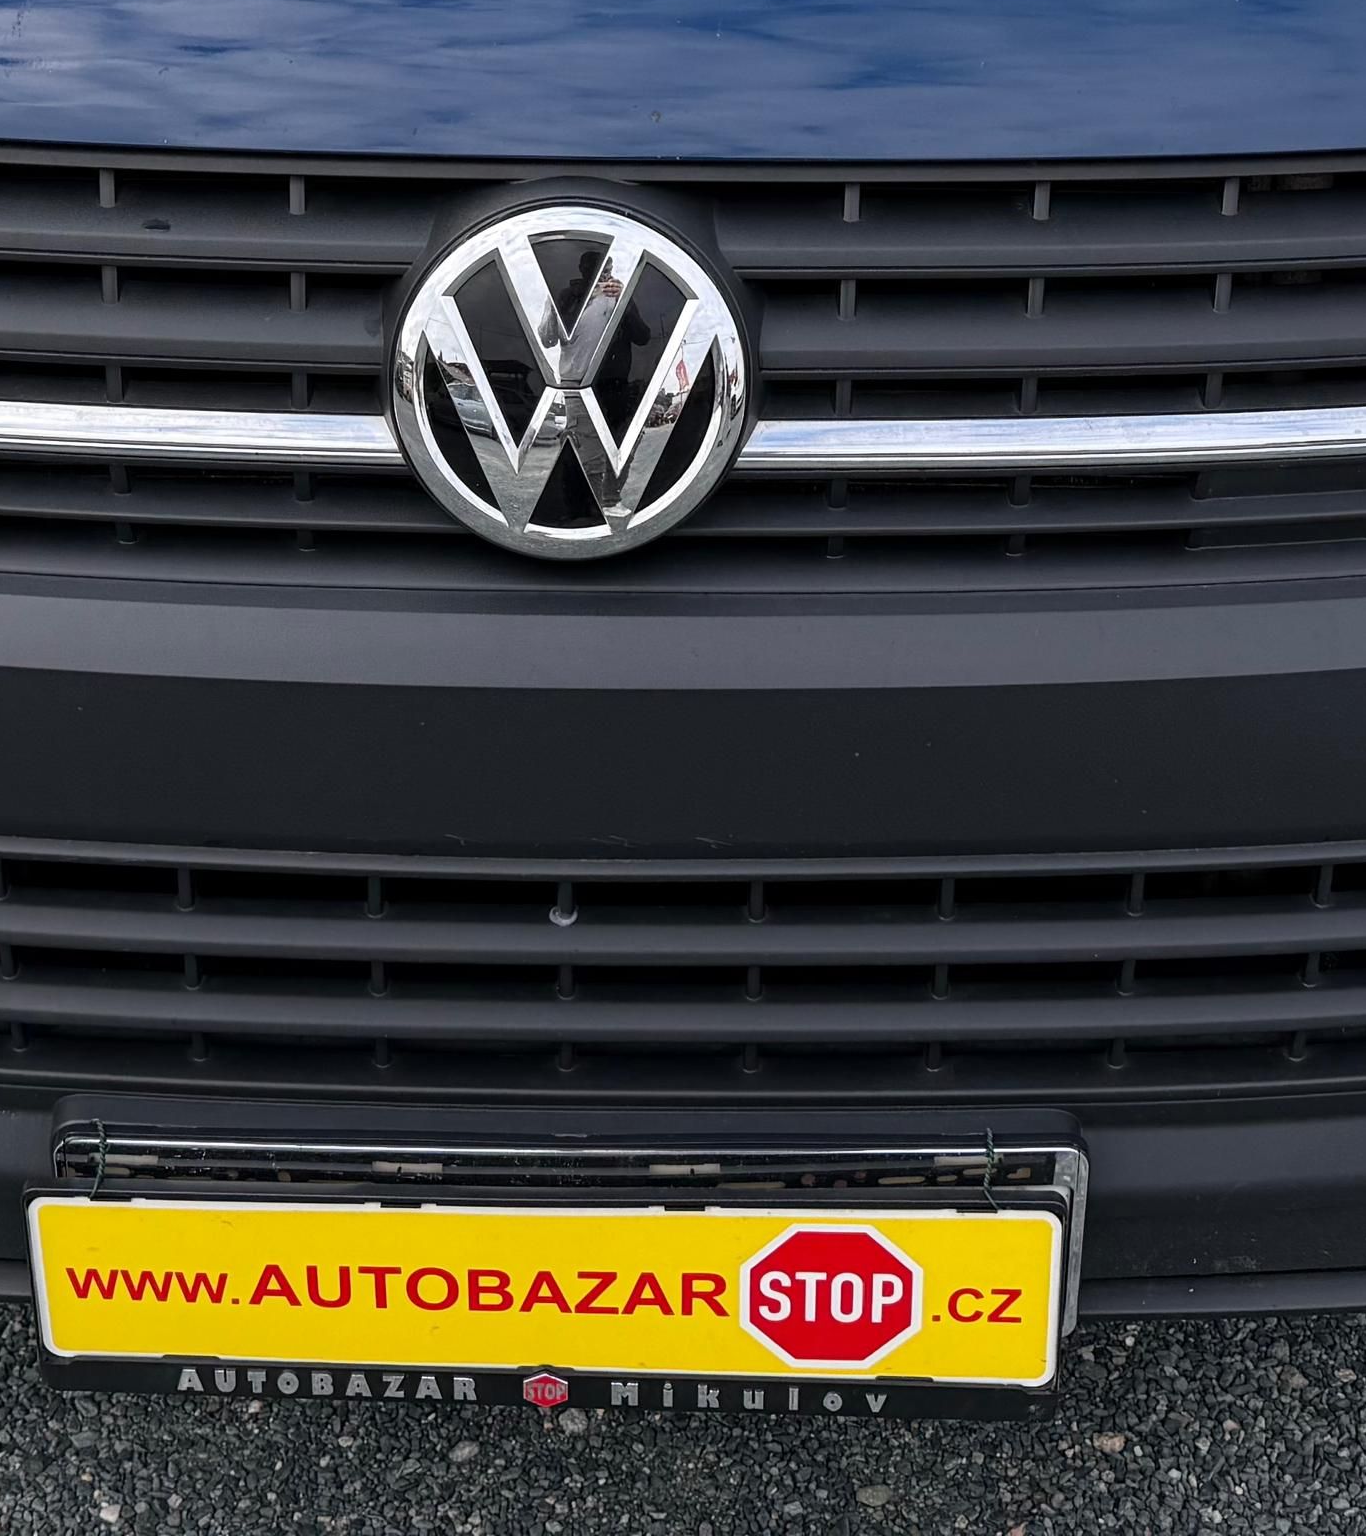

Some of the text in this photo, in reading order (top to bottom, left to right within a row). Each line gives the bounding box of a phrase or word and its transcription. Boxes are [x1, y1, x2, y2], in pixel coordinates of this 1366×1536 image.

[758, 1270, 904, 1324] STOP
[176, 1368, 888, 1414] AUTOBAZAR STOP Mikulov
